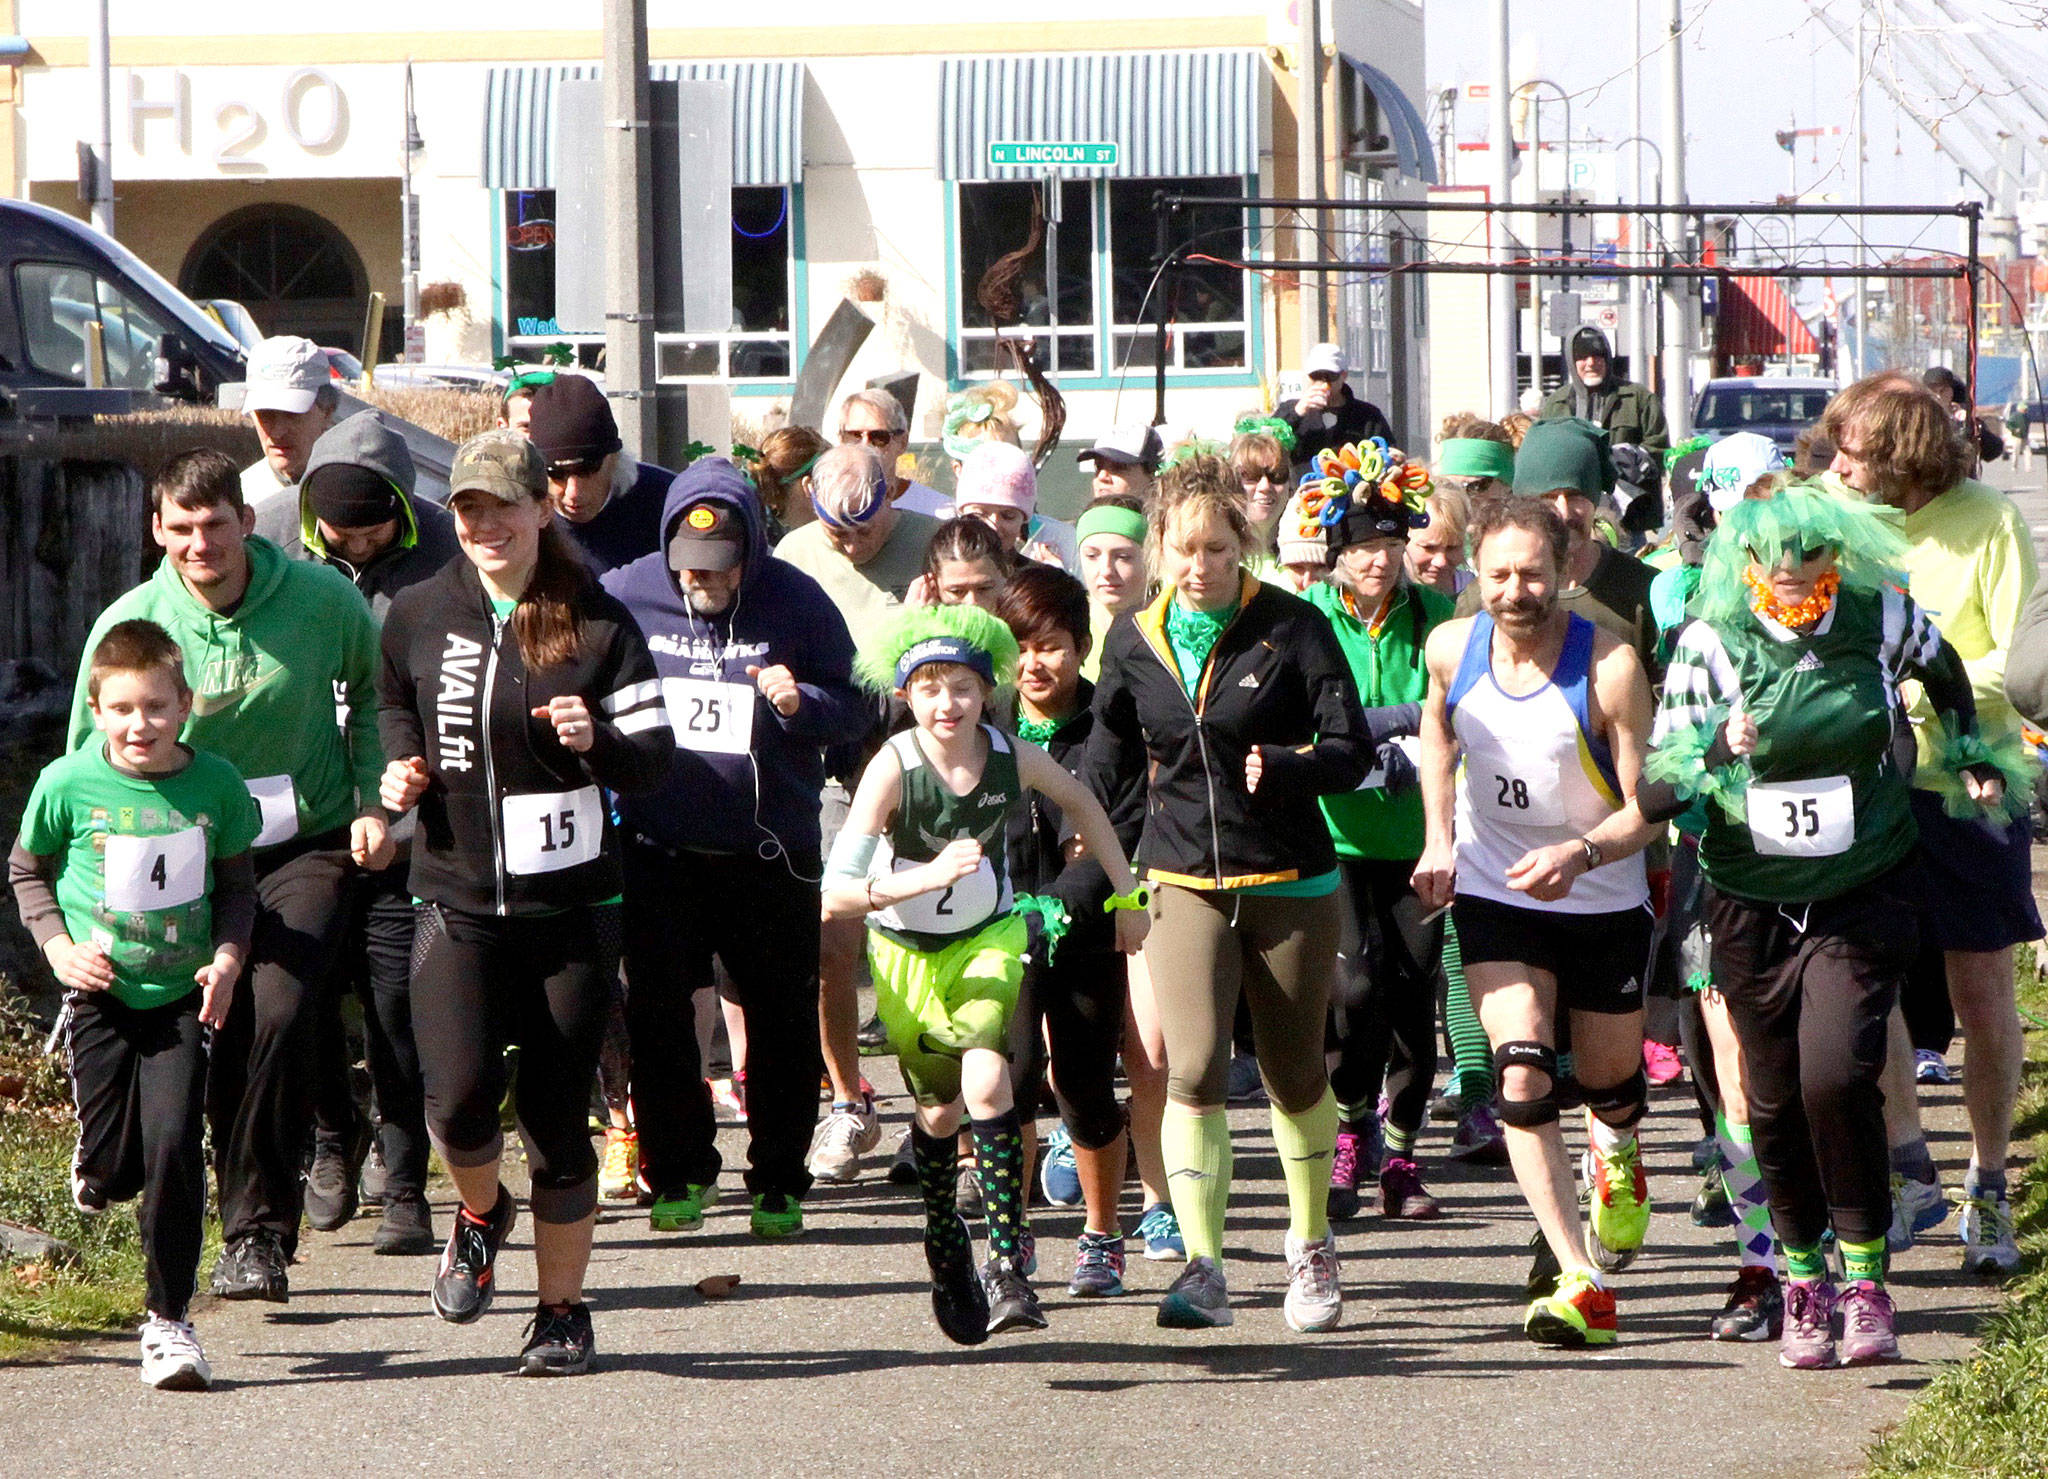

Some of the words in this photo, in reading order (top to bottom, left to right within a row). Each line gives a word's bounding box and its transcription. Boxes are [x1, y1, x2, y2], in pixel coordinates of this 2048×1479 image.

[127, 66, 341, 168] H2O
[995, 149, 1005, 160] N
[1015, 146, 1085, 161] LINCOLN
[1096, 150, 1111, 161] ST
[436, 632, 482, 772] AVAILfit
[688, 697, 721, 733] 25
[1494, 774, 1530, 810] 28
[539, 809, 576, 853] 15
[1781, 797, 1820, 838] 35
[150, 853, 167, 891] 4
